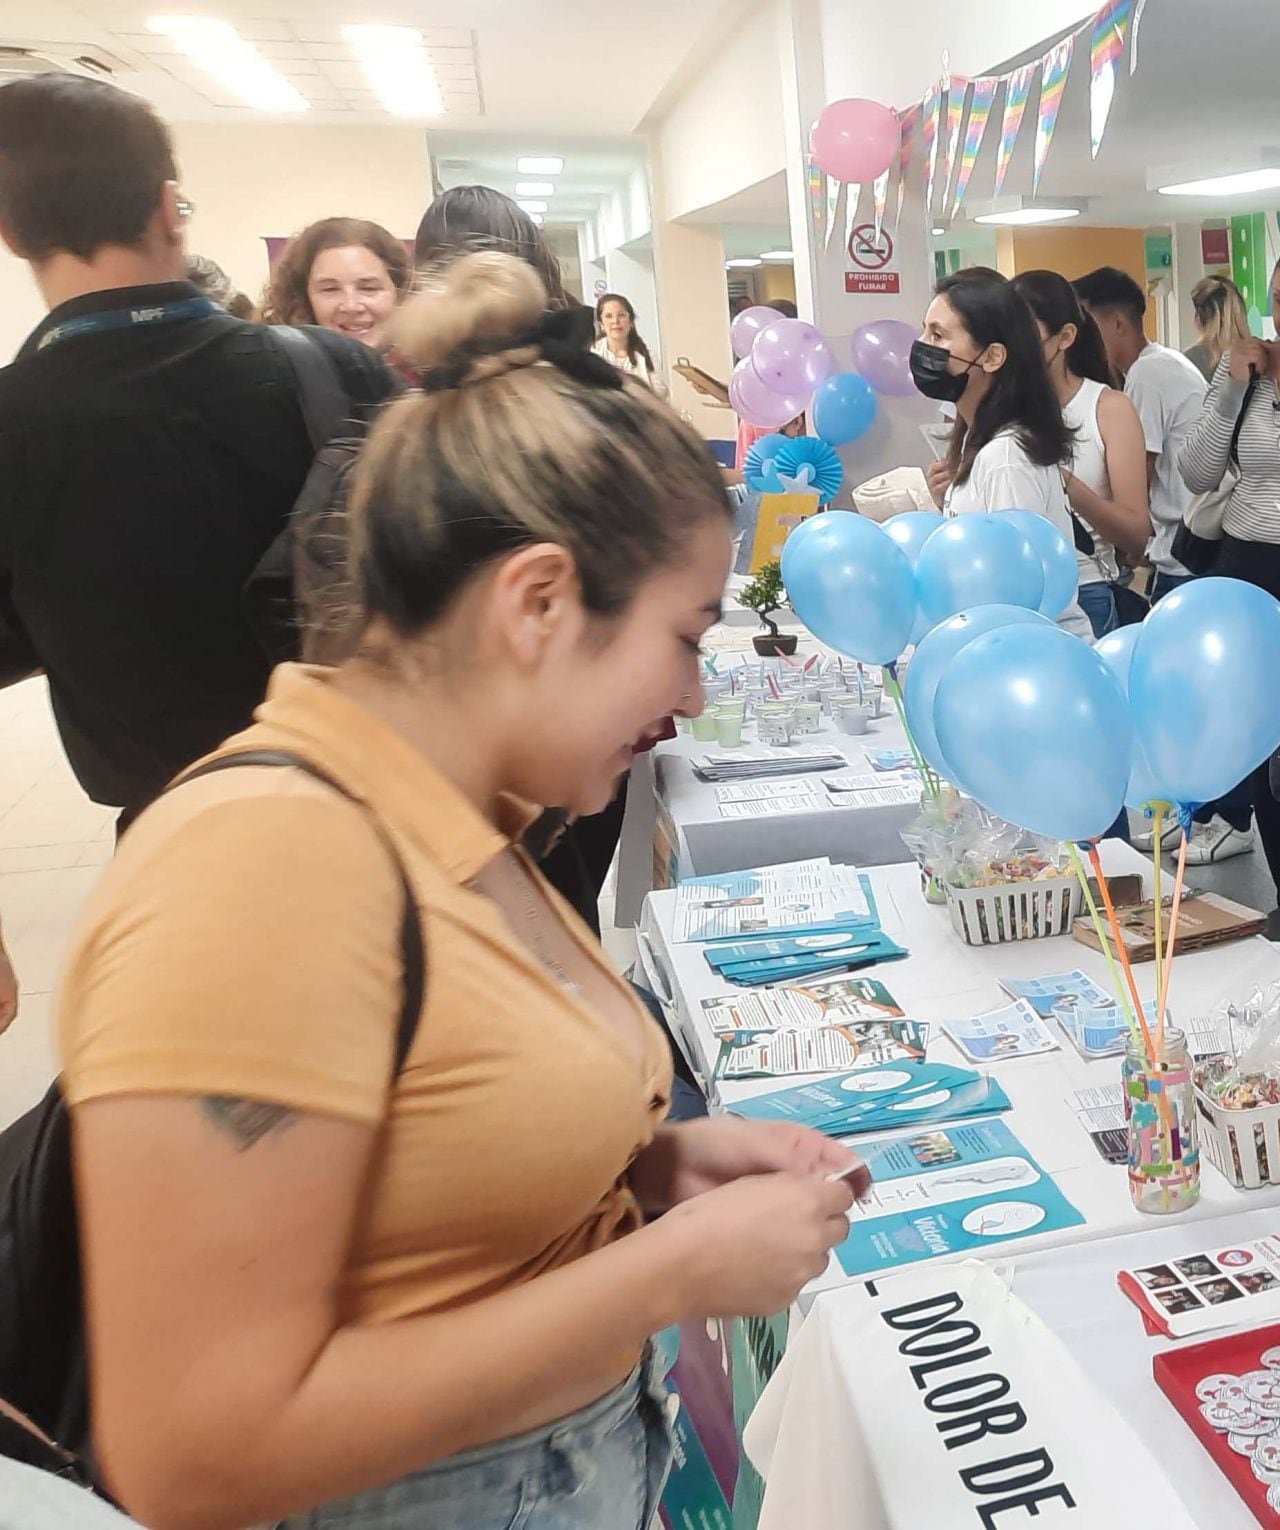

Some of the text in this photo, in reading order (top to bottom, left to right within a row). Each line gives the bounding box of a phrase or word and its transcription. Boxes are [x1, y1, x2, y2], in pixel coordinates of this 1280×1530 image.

[848, 272, 895, 281] PROHIBIDO
[858, 282, 887, 290] FUMAR
[880, 1291, 1028, 1451] DOLOR
[958, 1446, 1078, 1530] DE
